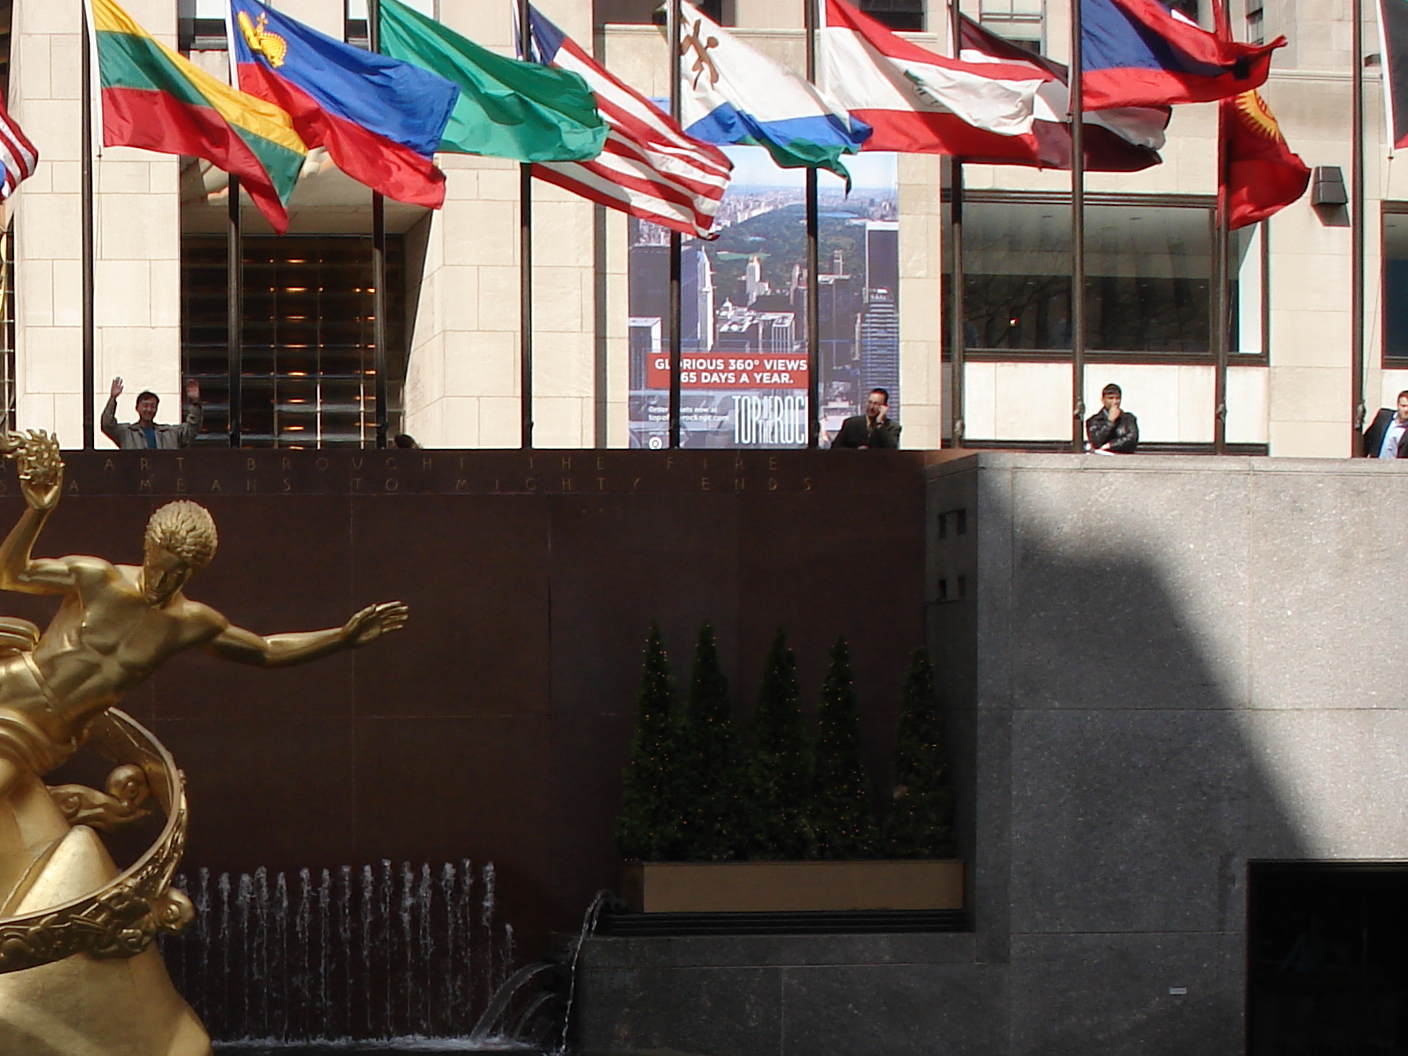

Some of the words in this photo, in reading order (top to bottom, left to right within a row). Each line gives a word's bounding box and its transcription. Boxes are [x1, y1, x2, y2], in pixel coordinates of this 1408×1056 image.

[654, 358, 725, 371] GLRIOUS
[680, 372, 697, 384] 65
[701, 372, 736, 384] DAYS
[739, 372, 750, 384] A
[753, 372, 794, 384] YEAR.
[732, 395, 761, 444] TOP
[103, 458, 185, 472] ART
[246, 457, 468, 472] BROUGHT
[528, 457, 605, 471] THE
[666, 456, 779, 471] FIRE
[68, 480, 81, 493] A
[138, 478, 292, 492] MEANS
[352, 477, 399, 492] TO
[455, 477, 642, 491] MIGHTY
[701, 477, 813, 491] ENDS
